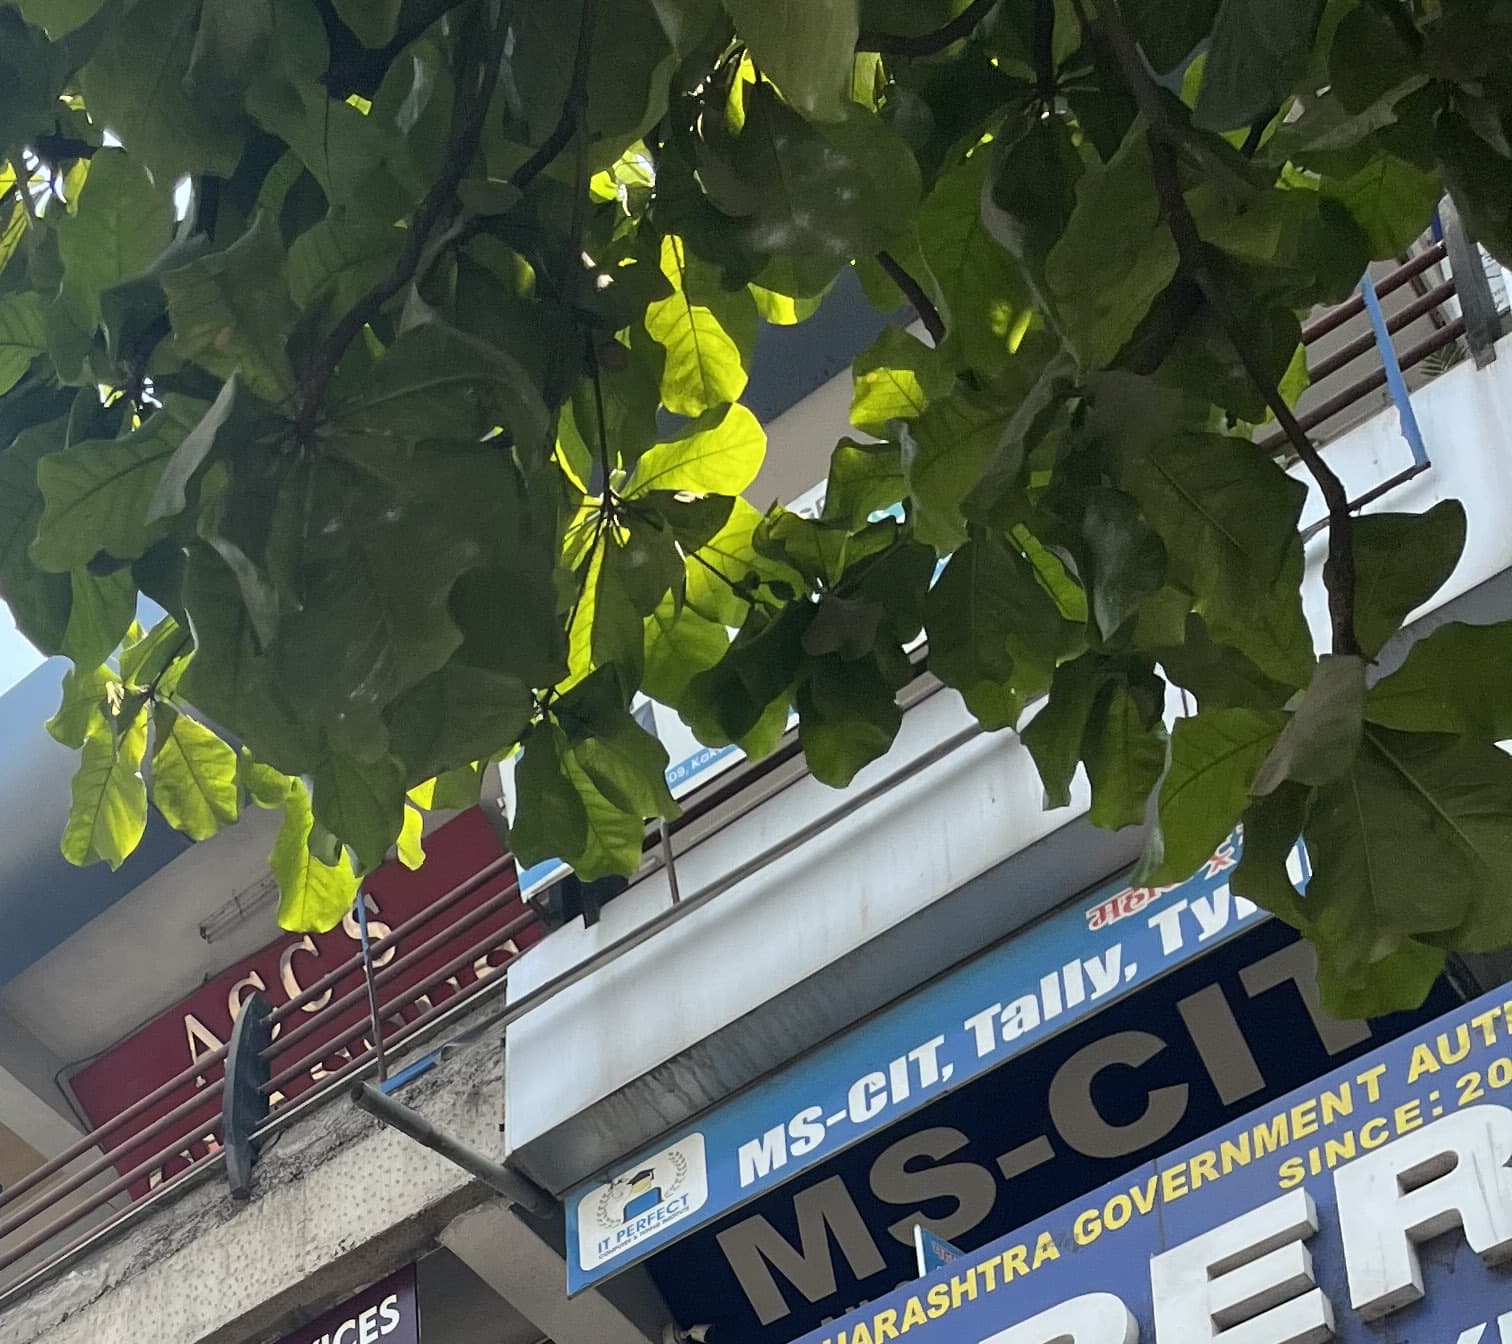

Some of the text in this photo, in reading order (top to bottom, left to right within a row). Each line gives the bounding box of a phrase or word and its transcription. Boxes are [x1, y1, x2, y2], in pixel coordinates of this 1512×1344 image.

[716, 936, 1372, 1326] MS-CIT
[738, 944, 1138, 1188] MS-CIT, Tally,
[1073, 1063, 1387, 1246] GOVERNMENT
[1278, 1089, 1444, 1190] SINCE:
[597, 1193, 690, 1255] IT PERFECT
